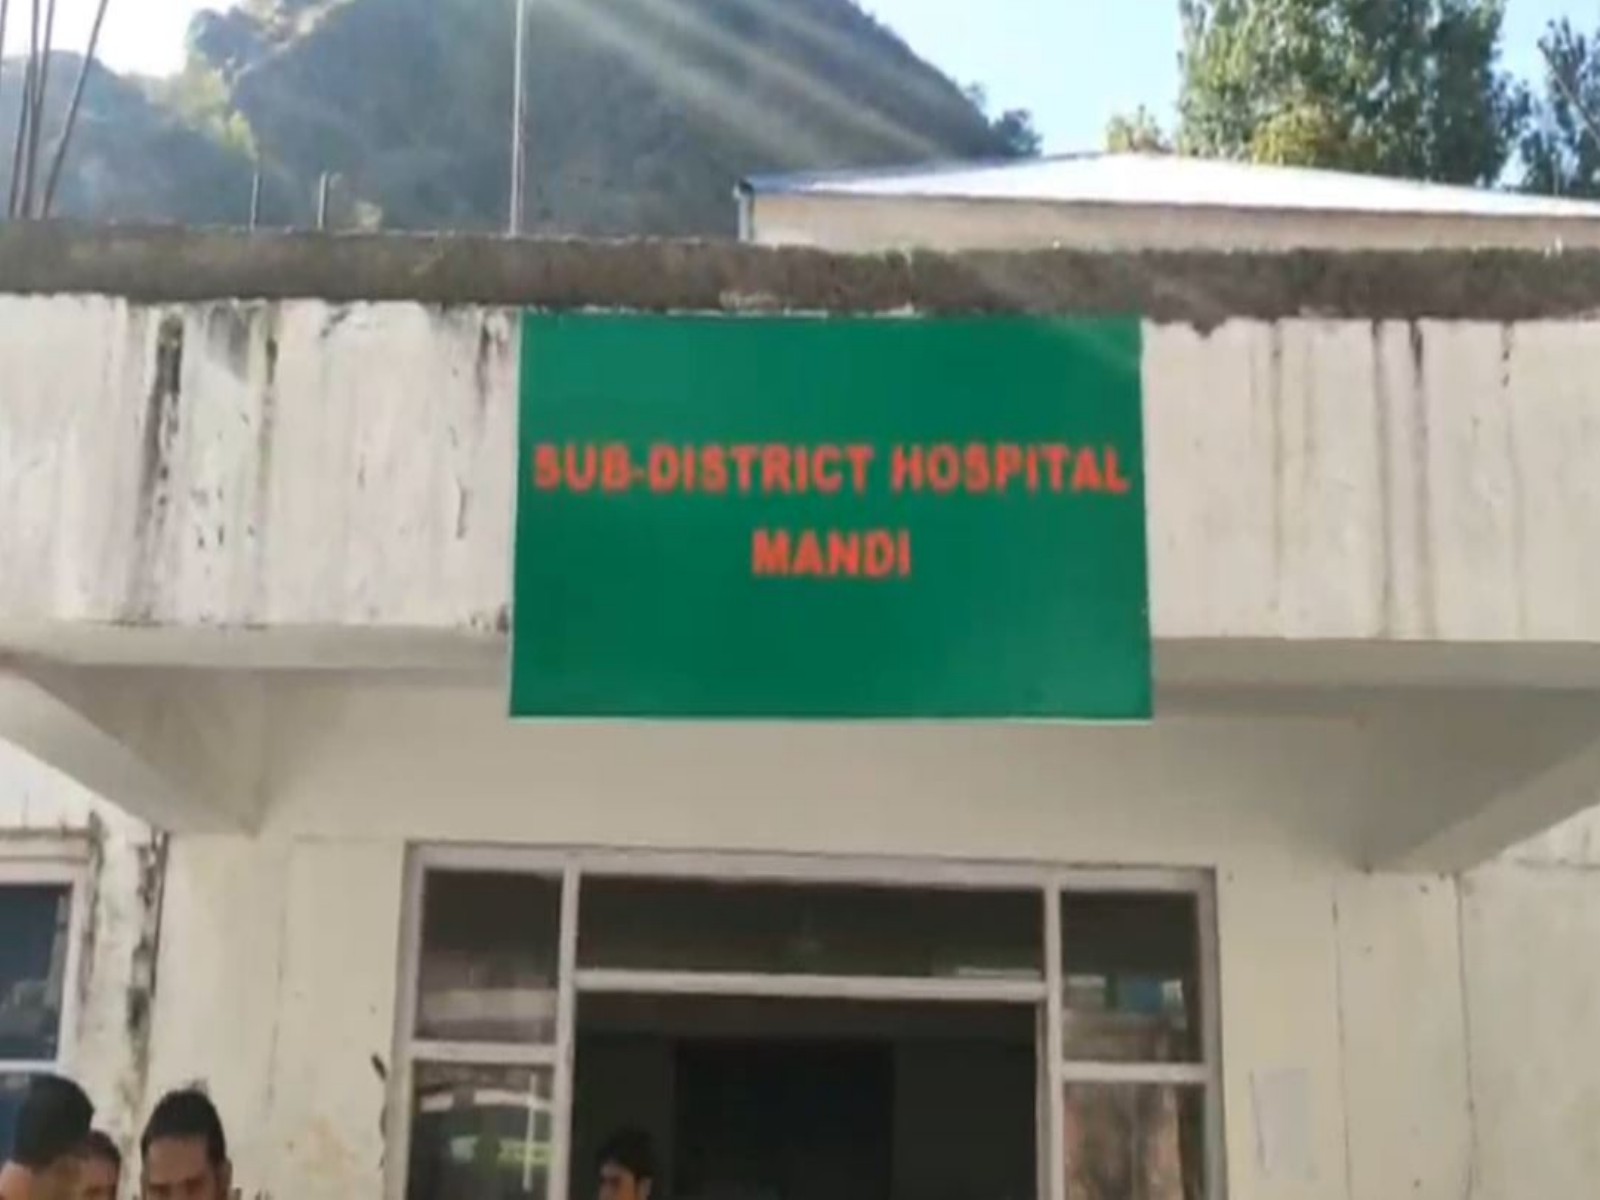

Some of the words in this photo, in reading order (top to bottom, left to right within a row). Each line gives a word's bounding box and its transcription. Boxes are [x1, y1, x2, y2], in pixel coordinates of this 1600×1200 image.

[534, 443, 873, 493] SUB-DISTRICT
[891, 443, 1129, 494] HOSPITAL
[751, 530, 911, 578] MANDI
